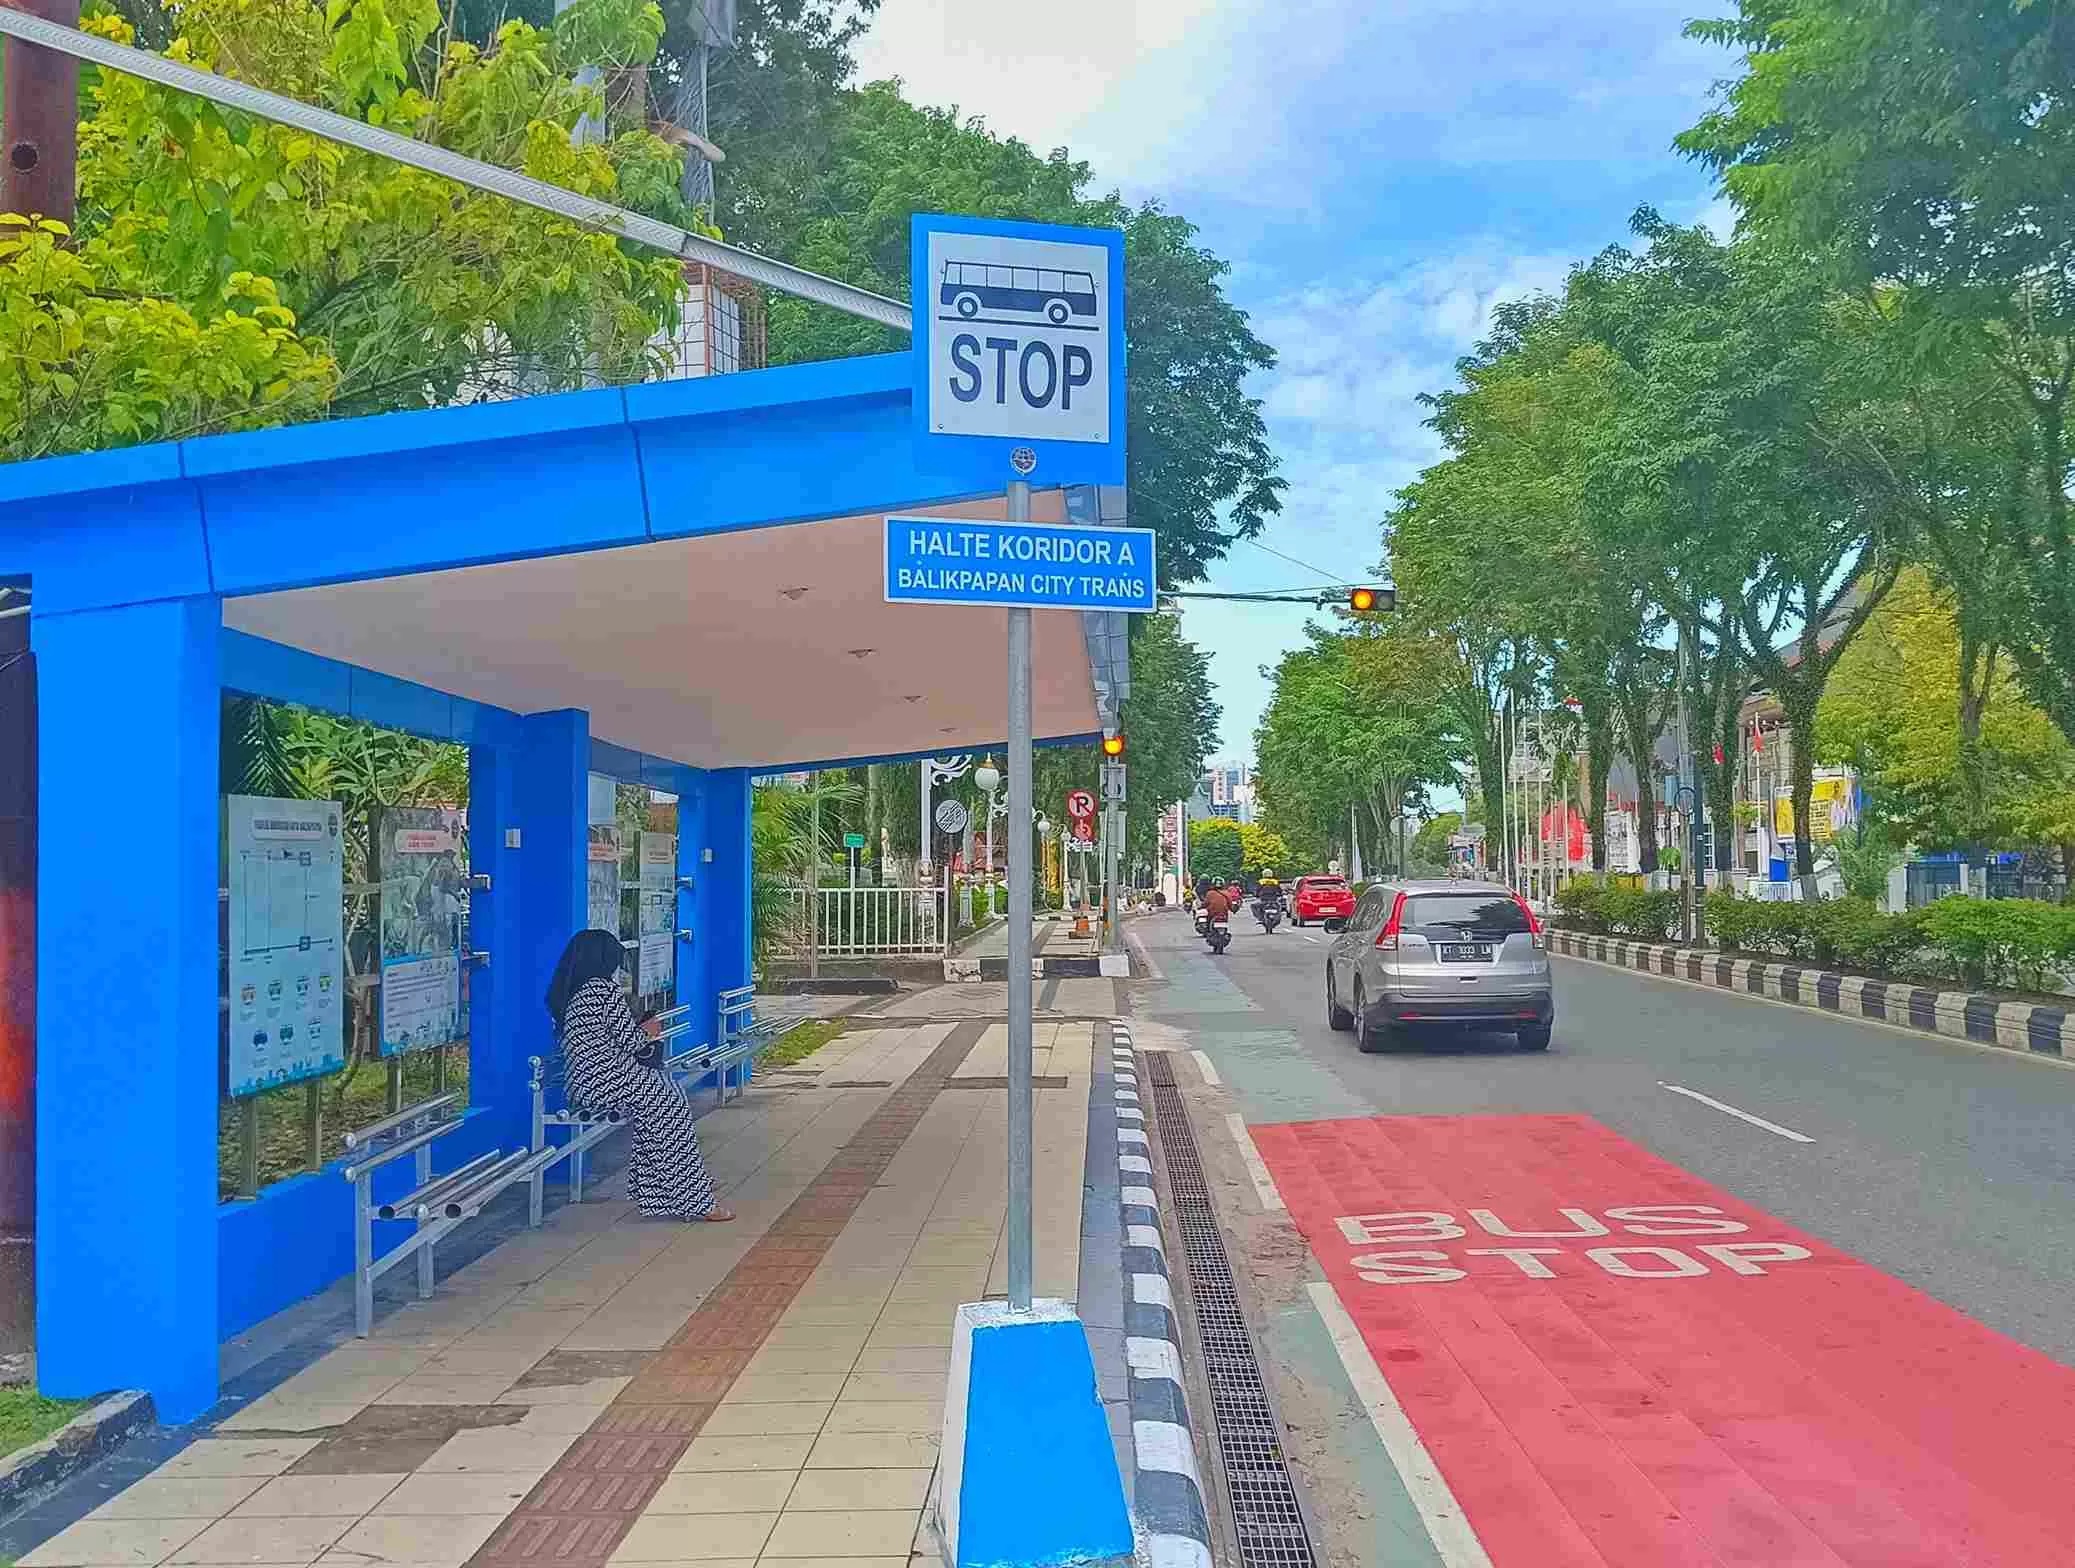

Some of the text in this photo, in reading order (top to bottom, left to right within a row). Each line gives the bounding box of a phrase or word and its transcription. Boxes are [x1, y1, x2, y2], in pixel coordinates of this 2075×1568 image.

[949, 333, 1093, 410] STOP
[909, 530, 1135, 566] HALTE KORIDOR A
[898, 568, 1145, 598] BALIKPAPAN CITY TRANS
[1334, 1204, 1750, 1245] BUS
[1350, 1242, 1813, 1285] STOP
